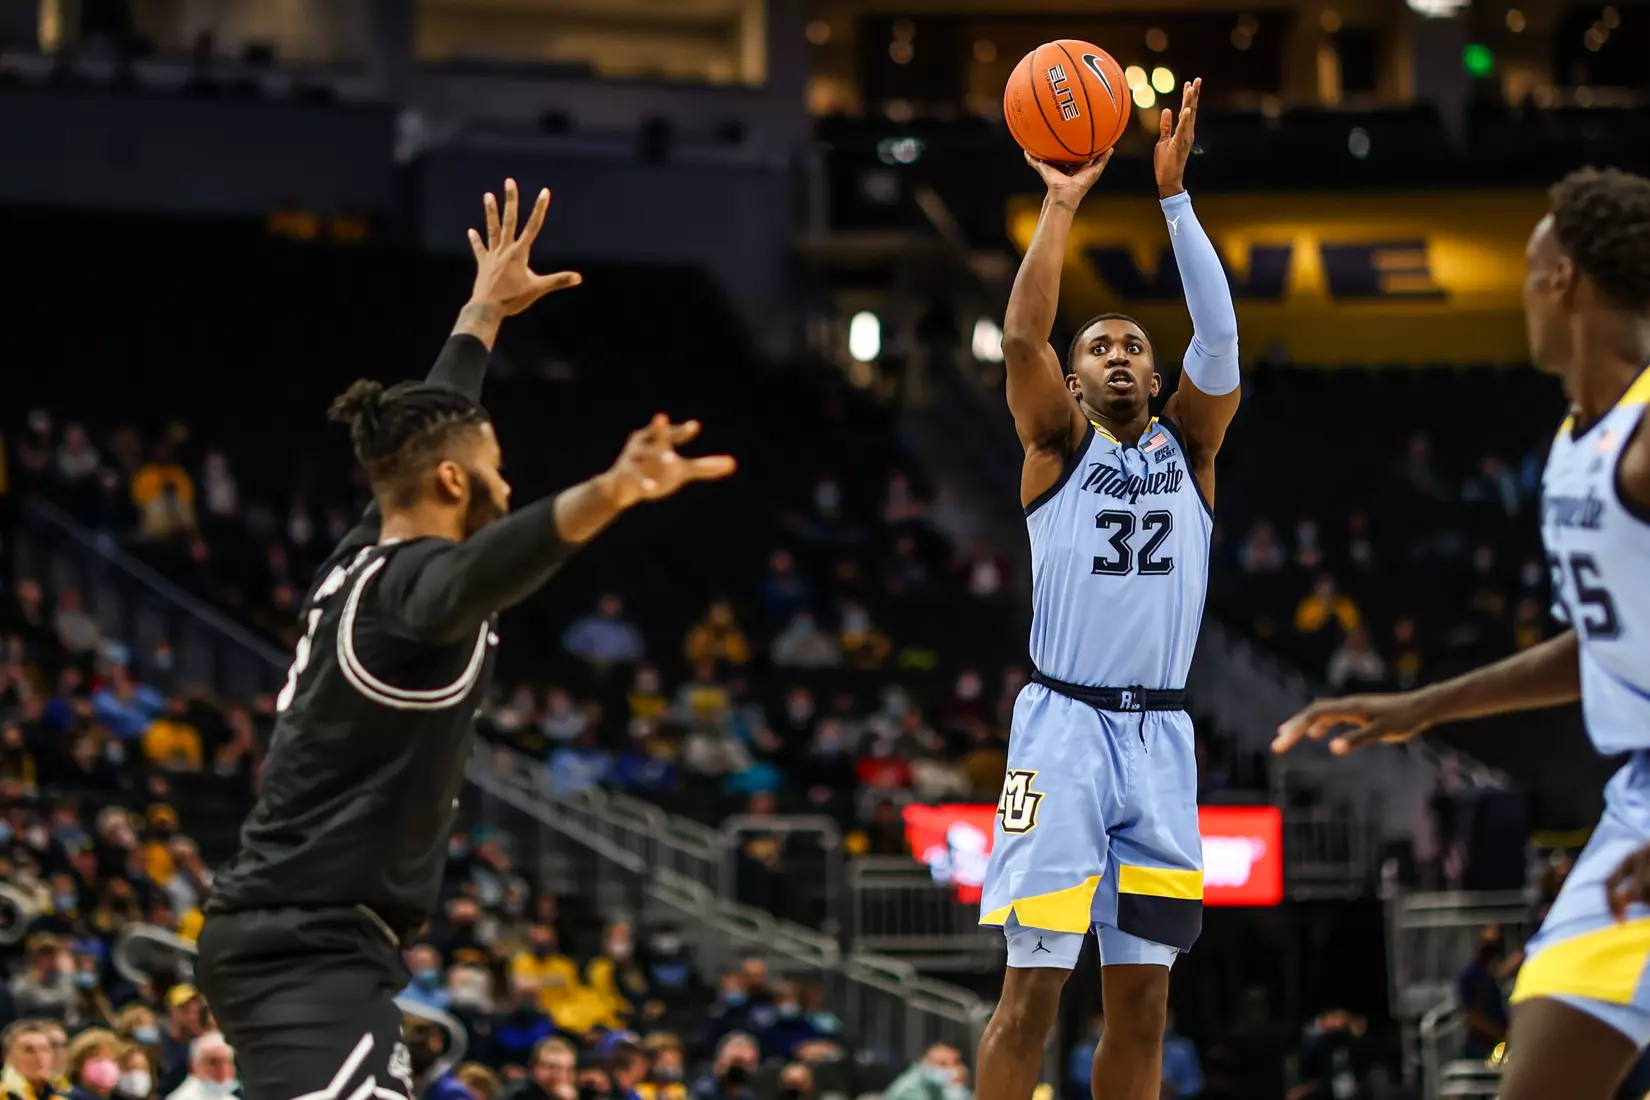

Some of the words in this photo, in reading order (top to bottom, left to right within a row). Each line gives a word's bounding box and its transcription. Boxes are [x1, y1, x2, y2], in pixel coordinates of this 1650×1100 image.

[1043, 69, 1065, 121] CHAMPIONSHIP
[1047, 64, 1081, 121] ELITE
[1154, 444, 1170, 456] BIG
[1155, 447, 1177, 462] EAST
[1081, 460, 1184, 505] Marquette
[1091, 509, 1175, 577] 32
[996, 769, 1046, 835] MU
